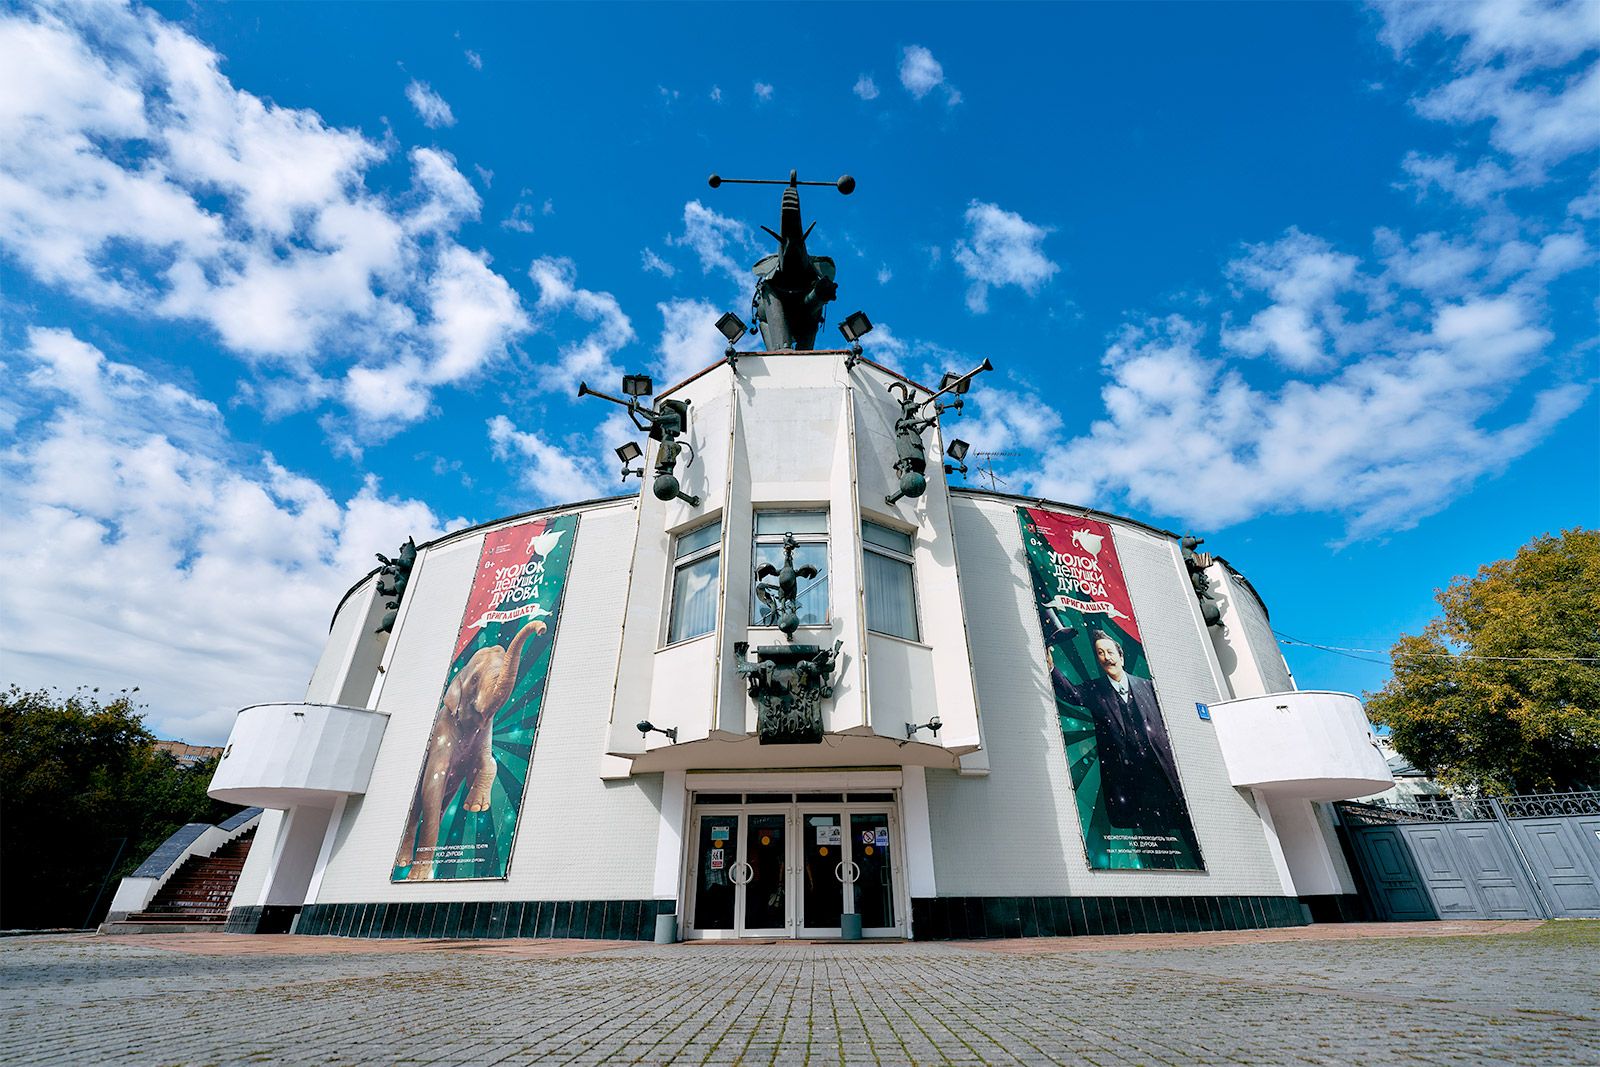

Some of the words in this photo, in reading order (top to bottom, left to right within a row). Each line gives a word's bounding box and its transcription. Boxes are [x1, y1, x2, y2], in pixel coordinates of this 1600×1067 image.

[1030, 537, 1042, 547] 0+
[484, 561, 495, 569] 0+
[495, 560, 546, 580] УГОЛОК
[1047, 550, 1102, 573] УГОЛОК
[1056, 577, 1108, 598] ДУРОВА
[488, 585, 539, 609] ДУРОВА
[1060, 597, 1110, 612] ПРИГЛАШАЕТ
[486, 605, 536, 620] ПРИГЛАШАЕТ
